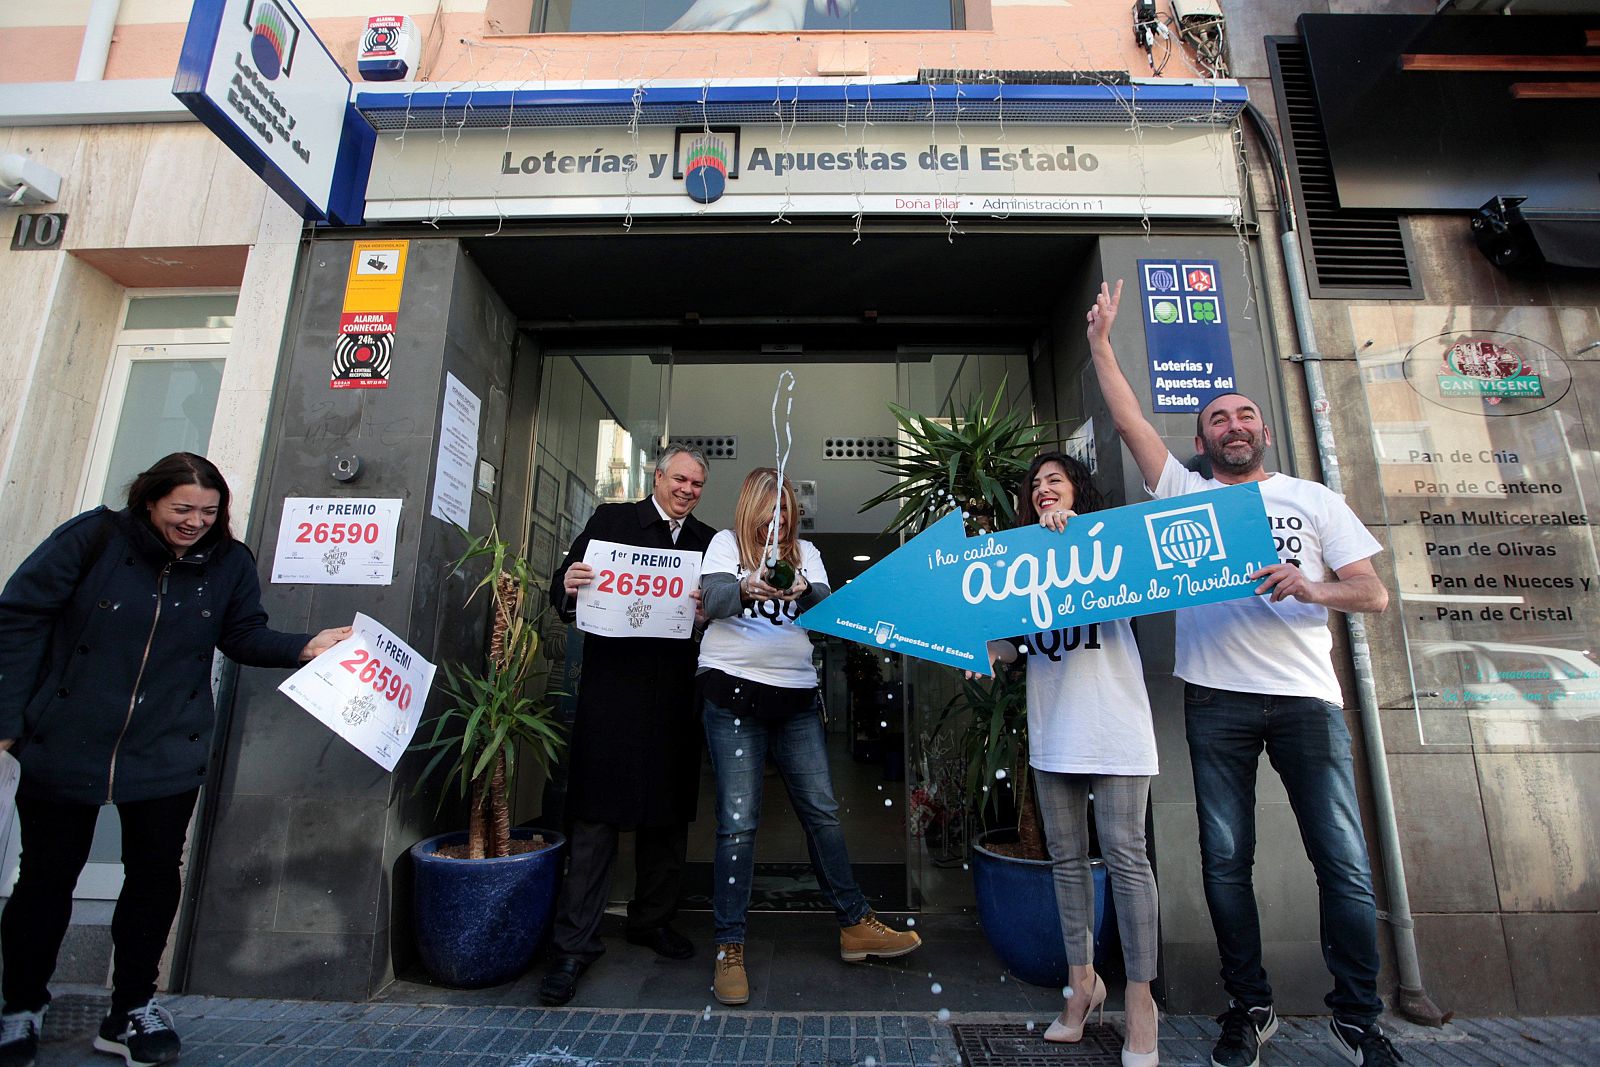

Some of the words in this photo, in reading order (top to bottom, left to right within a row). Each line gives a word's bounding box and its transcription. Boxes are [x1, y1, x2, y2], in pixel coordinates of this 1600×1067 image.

[227, 88, 274, 145] Estado
[231, 73, 290, 143] Apuestas
[292, 139, 311, 165] del
[287, 115, 297, 131] y
[502, 148, 638, 175] Loterías
[649, 153, 668, 178] y
[747, 147, 907, 176] Apuestas
[918, 145, 969, 171] del
[981, 146, 1099, 172] Estado
[895, 199, 930, 209] Doña
[935, 198, 961, 209] Pilar
[982, 198, 1079, 210] Administración
[1097, 200, 1104, 210] 1
[19, 214, 61, 246] 10
[353, 315, 385, 323] ALARMA
[343, 324, 393, 332] CONNECTADA
[357, 335, 375, 345] 24h.
[1153, 360, 1203, 372] Loterías
[1205, 362, 1213, 374] y
[1156, 377, 1211, 390] Apuestas
[1214, 377, 1233, 388] del
[1440, 381, 1474, 390] CAN
[1480, 380, 1540, 393] VICENÇ
[1157, 394, 1199, 406] Estado
[1409, 450, 1444, 463] Pan
[1450, 450, 1473, 463] de
[1478, 450, 1520, 464] Chia
[1414, 480, 1450, 494] Pan
[1456, 480, 1479, 494] de
[1484, 481, 1563, 494] Centeno
[308, 503, 324, 515] 1er
[327, 504, 376, 515] PREMIO
[1420, 511, 1455, 525] Pan
[1461, 511, 1589, 525] Multicereales
[295, 522, 379, 544] 26590
[1425, 542, 1462, 556] Pan
[1468, 542, 1492, 556] de
[1497, 542, 1557, 556] Olivas
[610, 549, 628, 562] 1er
[631, 552, 681, 569] PREMIO
[962, 521, 1123, 629] aquí
[1431, 574, 1468, 588] Pan
[1474, 573, 1498, 588] de
[1504, 574, 1574, 589] Nueces
[1580, 577, 1591, 592] y
[597, 569, 684, 599] 26590
[1057, 603, 1075, 616] el
[1081, 588, 1144, 611] Gordo
[1147, 580, 1171, 600] de
[1436, 607, 1474, 621] Pan
[1480, 606, 1504, 621] de
[1509, 606, 1573, 622] Cristal
[836, 618, 867, 631] Loterías
[893, 633, 930, 648] Apuestas
[931, 643, 944, 653] del
[945, 647, 975, 660] Estado
[376, 633, 385, 650] 1r
[384, 639, 412, 671] PREMI
[339, 649, 413, 711] 26590
